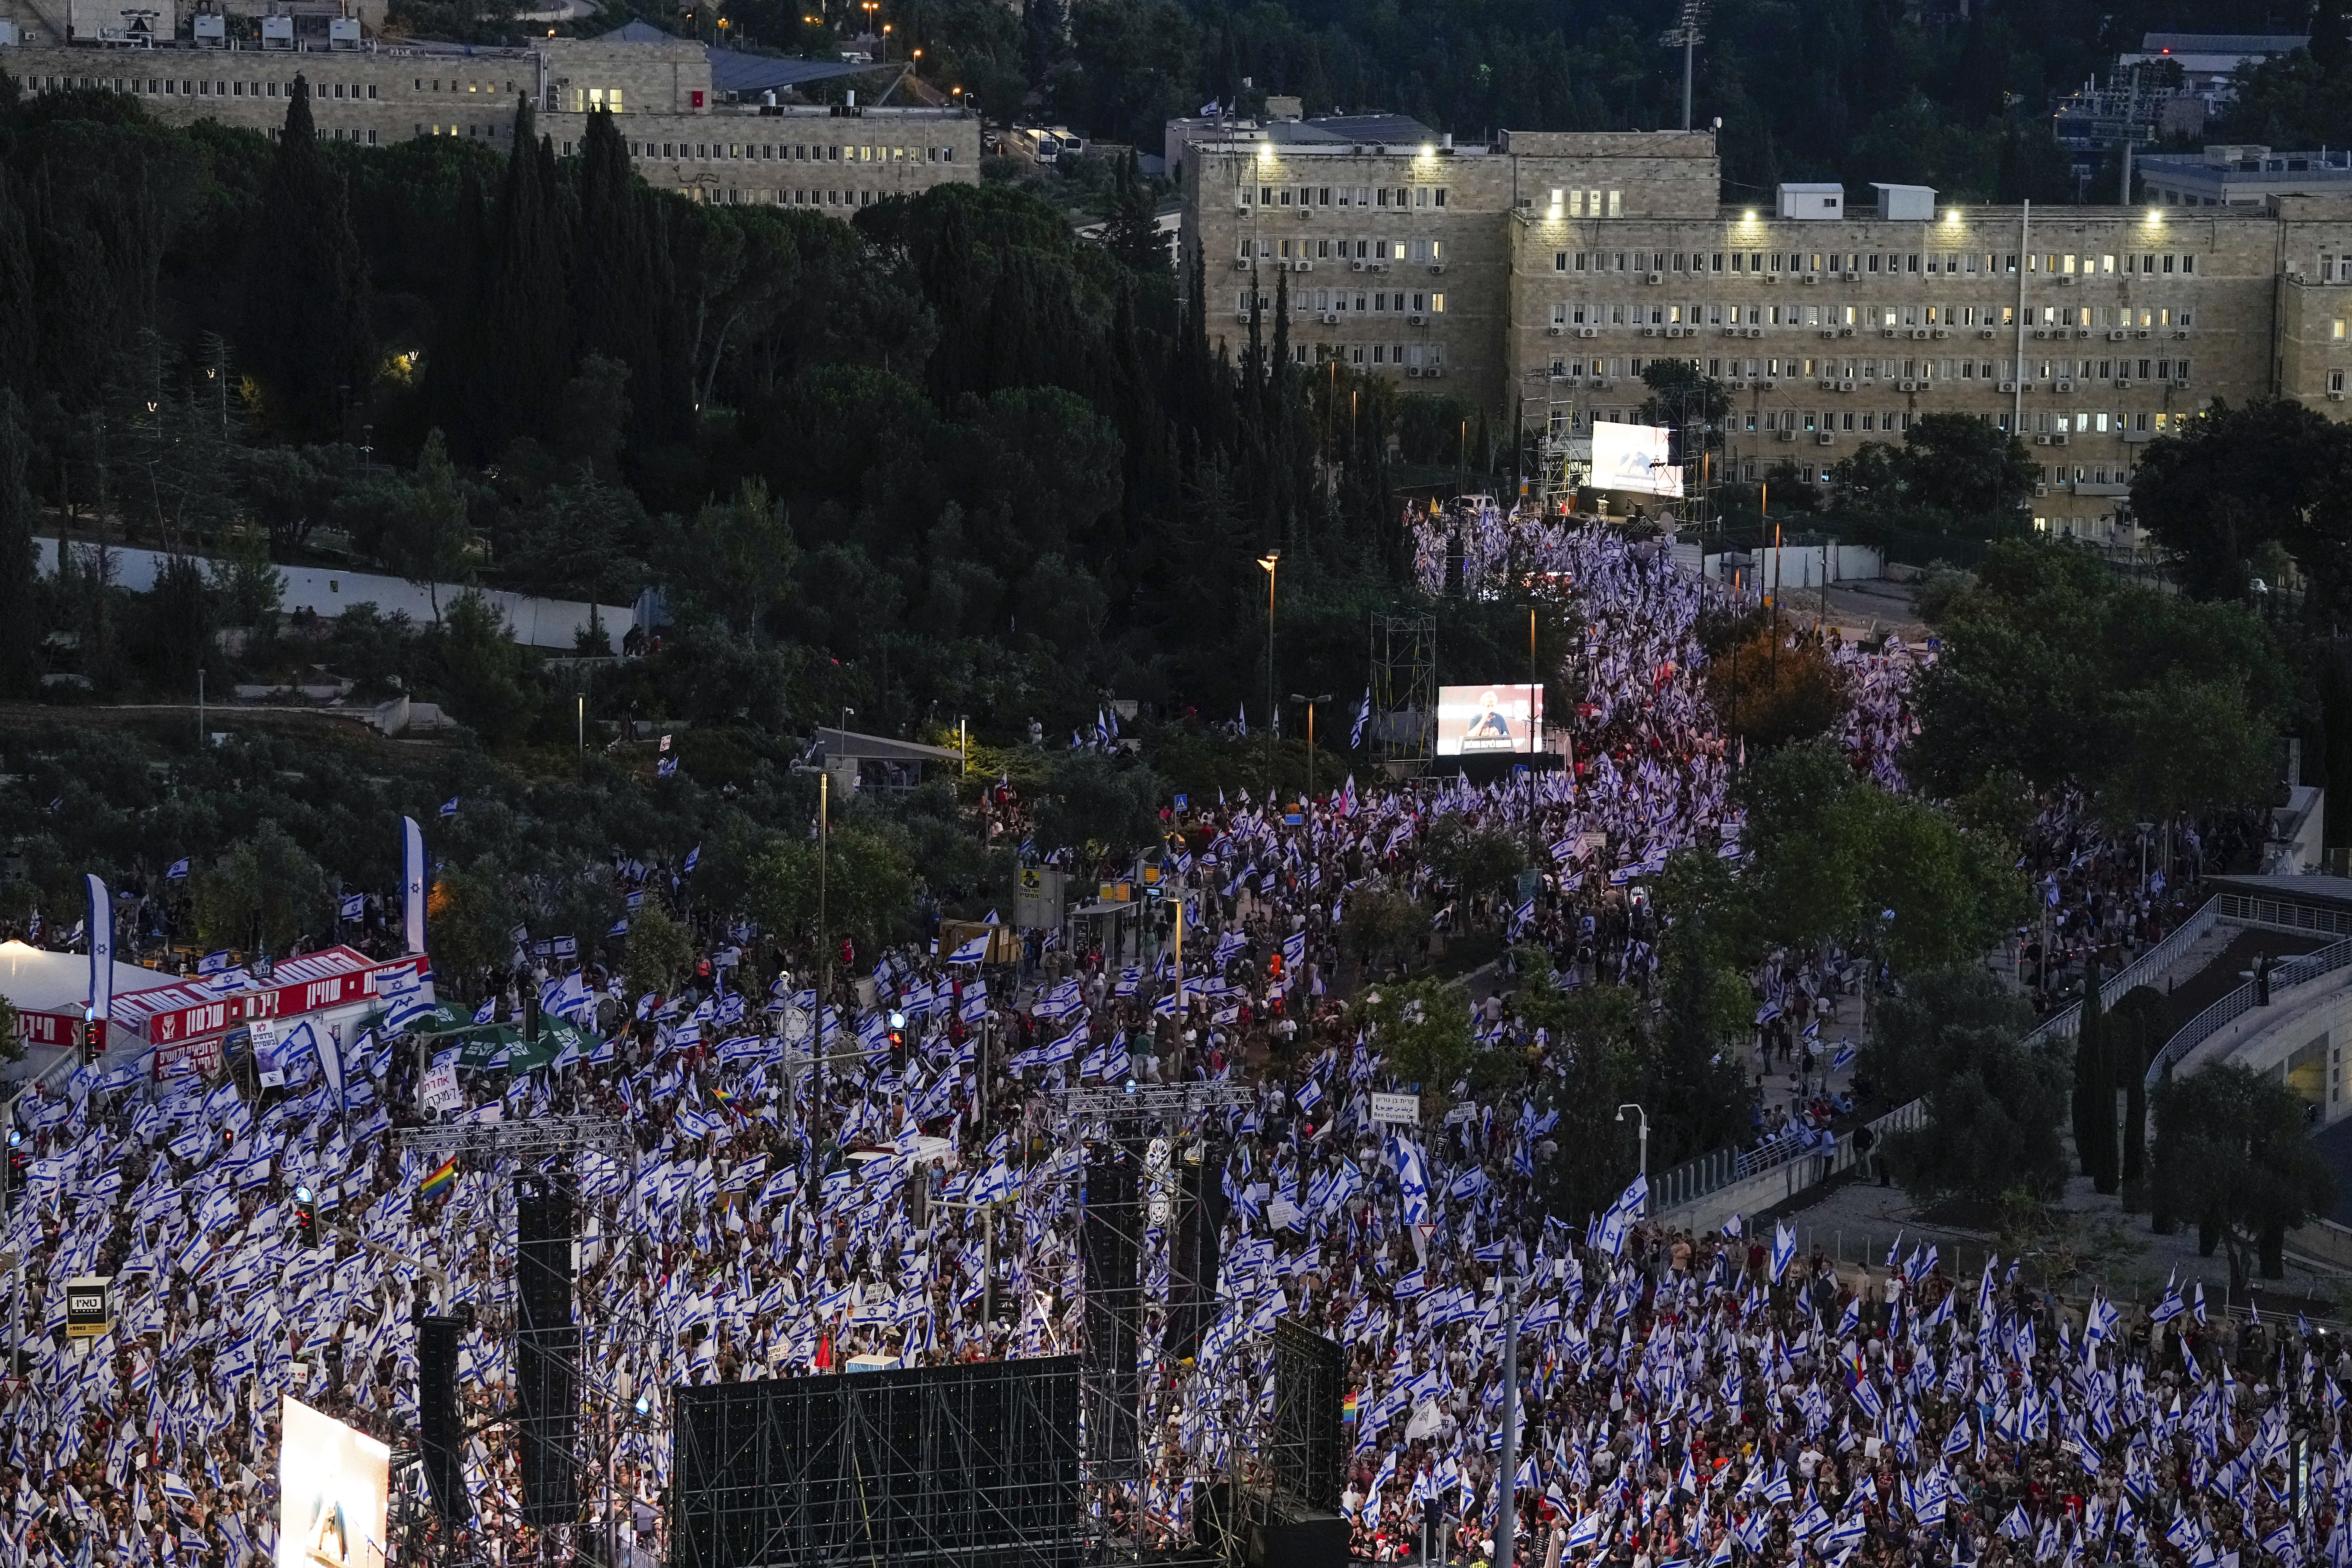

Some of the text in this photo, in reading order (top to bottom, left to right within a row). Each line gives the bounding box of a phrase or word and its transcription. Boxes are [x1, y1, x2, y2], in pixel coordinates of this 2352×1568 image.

[307, 978, 341, 1009] שוויון
[186, 1004, 224, 1037] שלטון
[256, 1022, 266, 1033] לא
[253, 1032, 273, 1041] נרדמים
[253, 1039, 276, 1048] בשמירה
[187, 1040, 218, 1056] הרופאים
[439, 1063, 450, 1075] אין
[424, 1076, 450, 1093] אחרת
